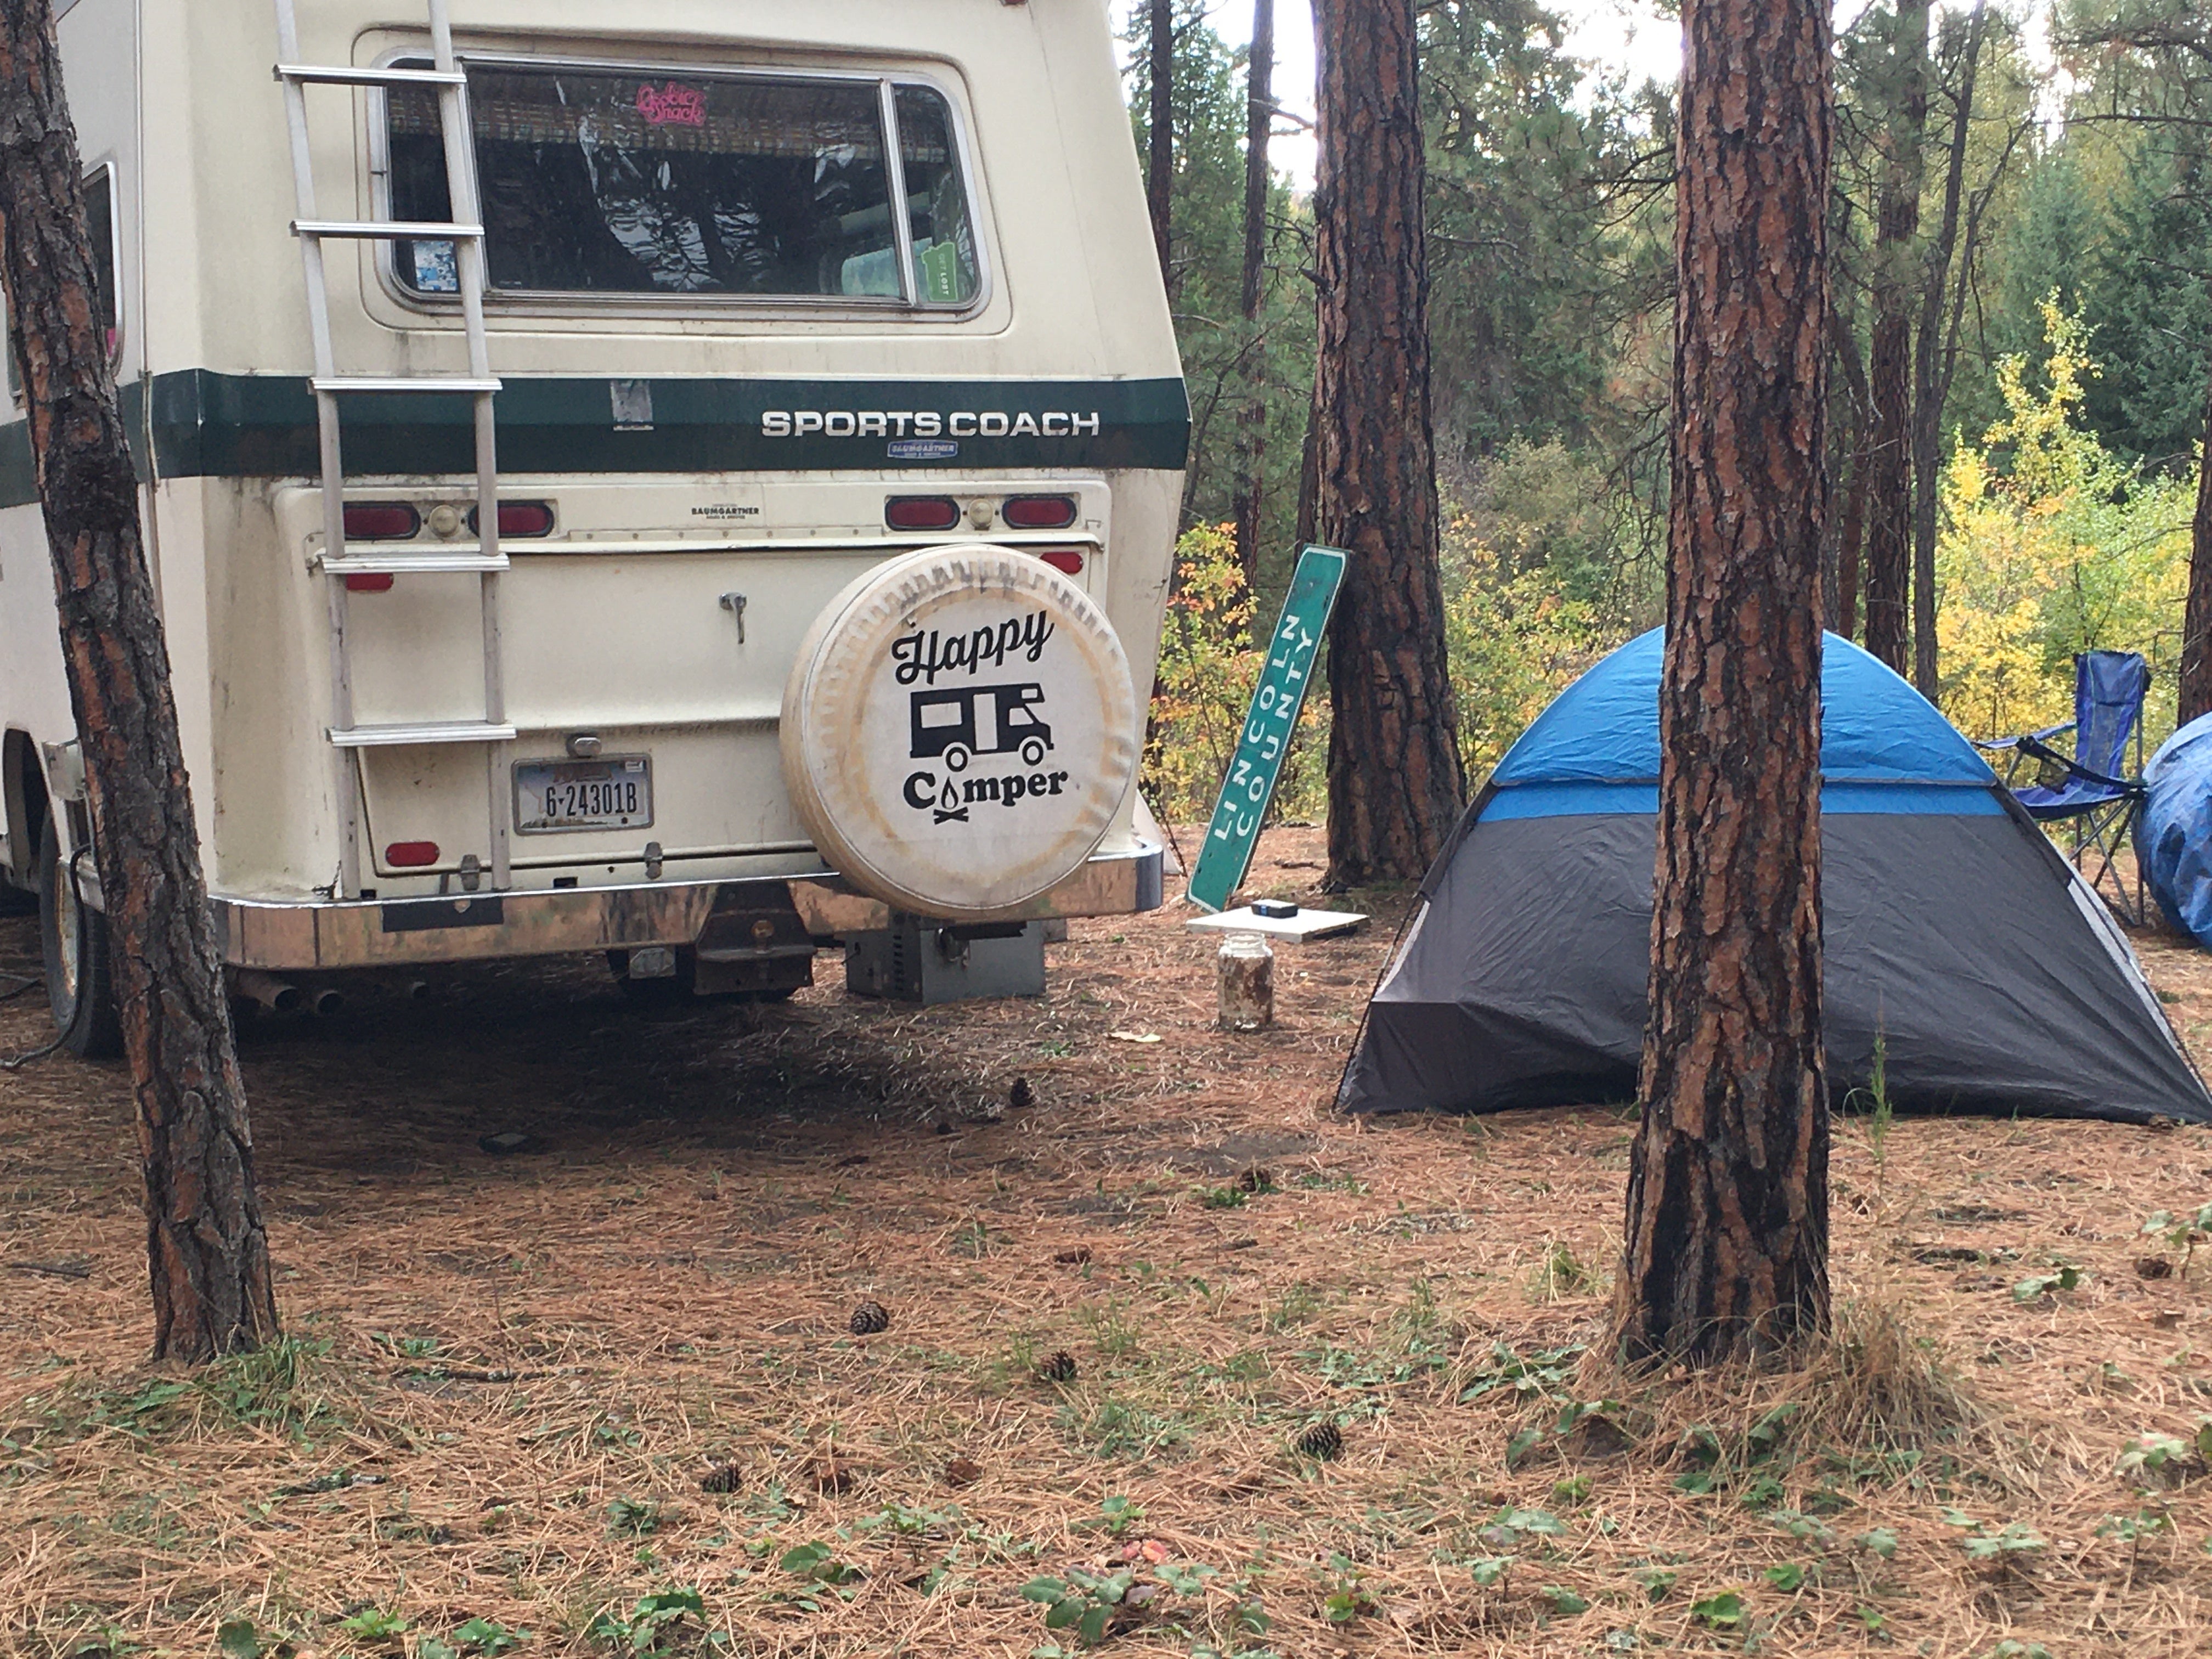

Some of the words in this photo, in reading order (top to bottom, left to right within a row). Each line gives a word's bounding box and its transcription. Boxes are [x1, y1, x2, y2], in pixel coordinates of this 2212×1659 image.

[940, 272, 949, 295] LOST
[761, 411, 941, 437] SPORTS
[949, 411, 1099, 437] COACH
[691, 507, 759, 515] BAUMGARTNER
[891, 610, 1055, 686] Happy
[1214, 614, 1300, 840] LINCOLN
[1236, 627, 1313, 838] COUNTY
